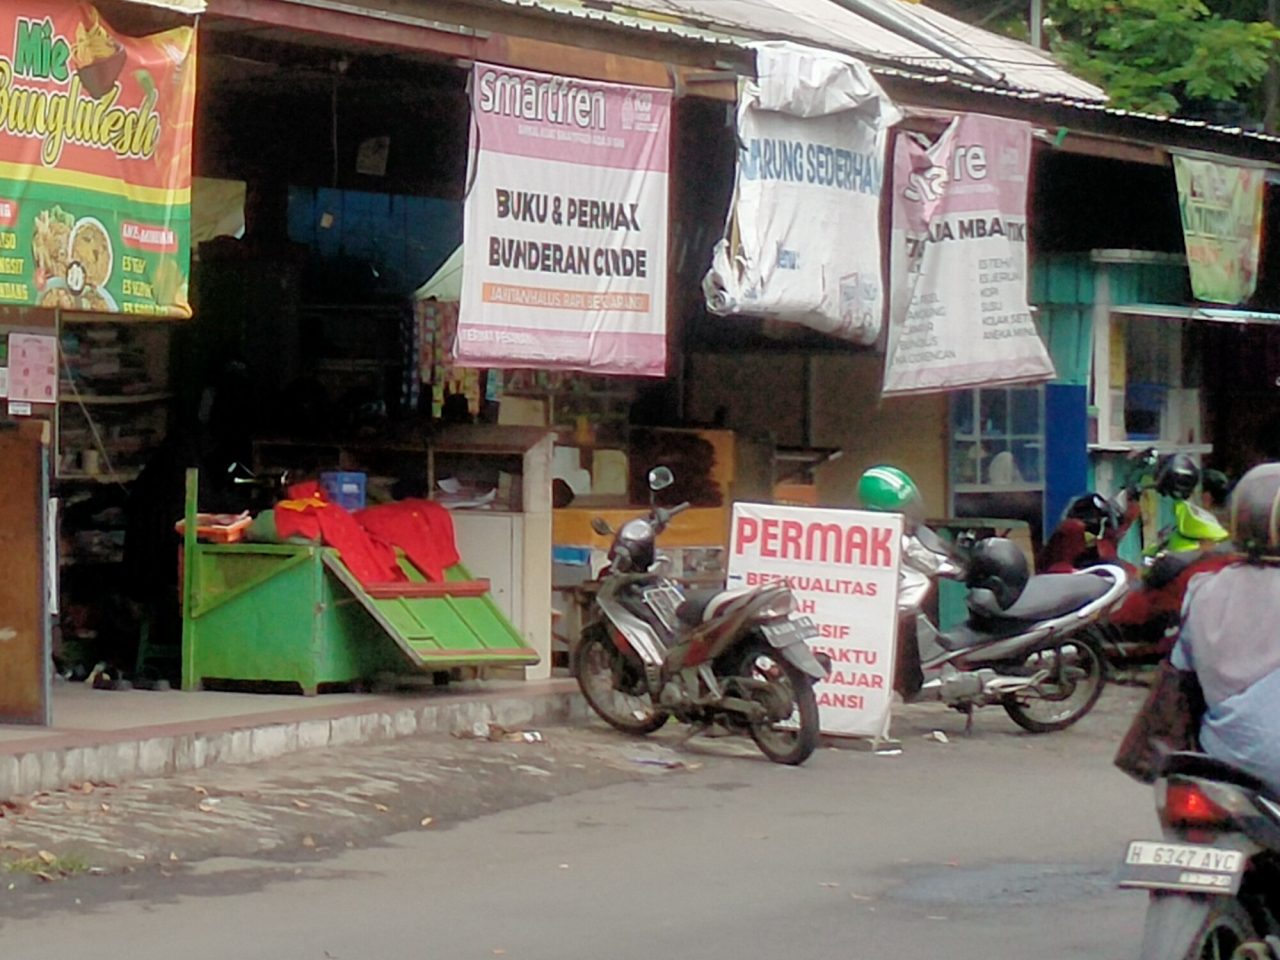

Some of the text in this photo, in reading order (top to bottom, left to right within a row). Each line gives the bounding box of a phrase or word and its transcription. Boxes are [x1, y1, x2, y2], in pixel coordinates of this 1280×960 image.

[13, 16, 71, 82] Mie
[480, 70, 607, 130] smartfren
[496, 188, 549, 224] BUKU
[552, 196, 563, 226] &
[489, 236, 590, 275] BUNDERAN
[735, 517, 893, 567] PERMAK
[1131, 845, 1143, 862] H
[1153, 847, 1197, 866] 6347
